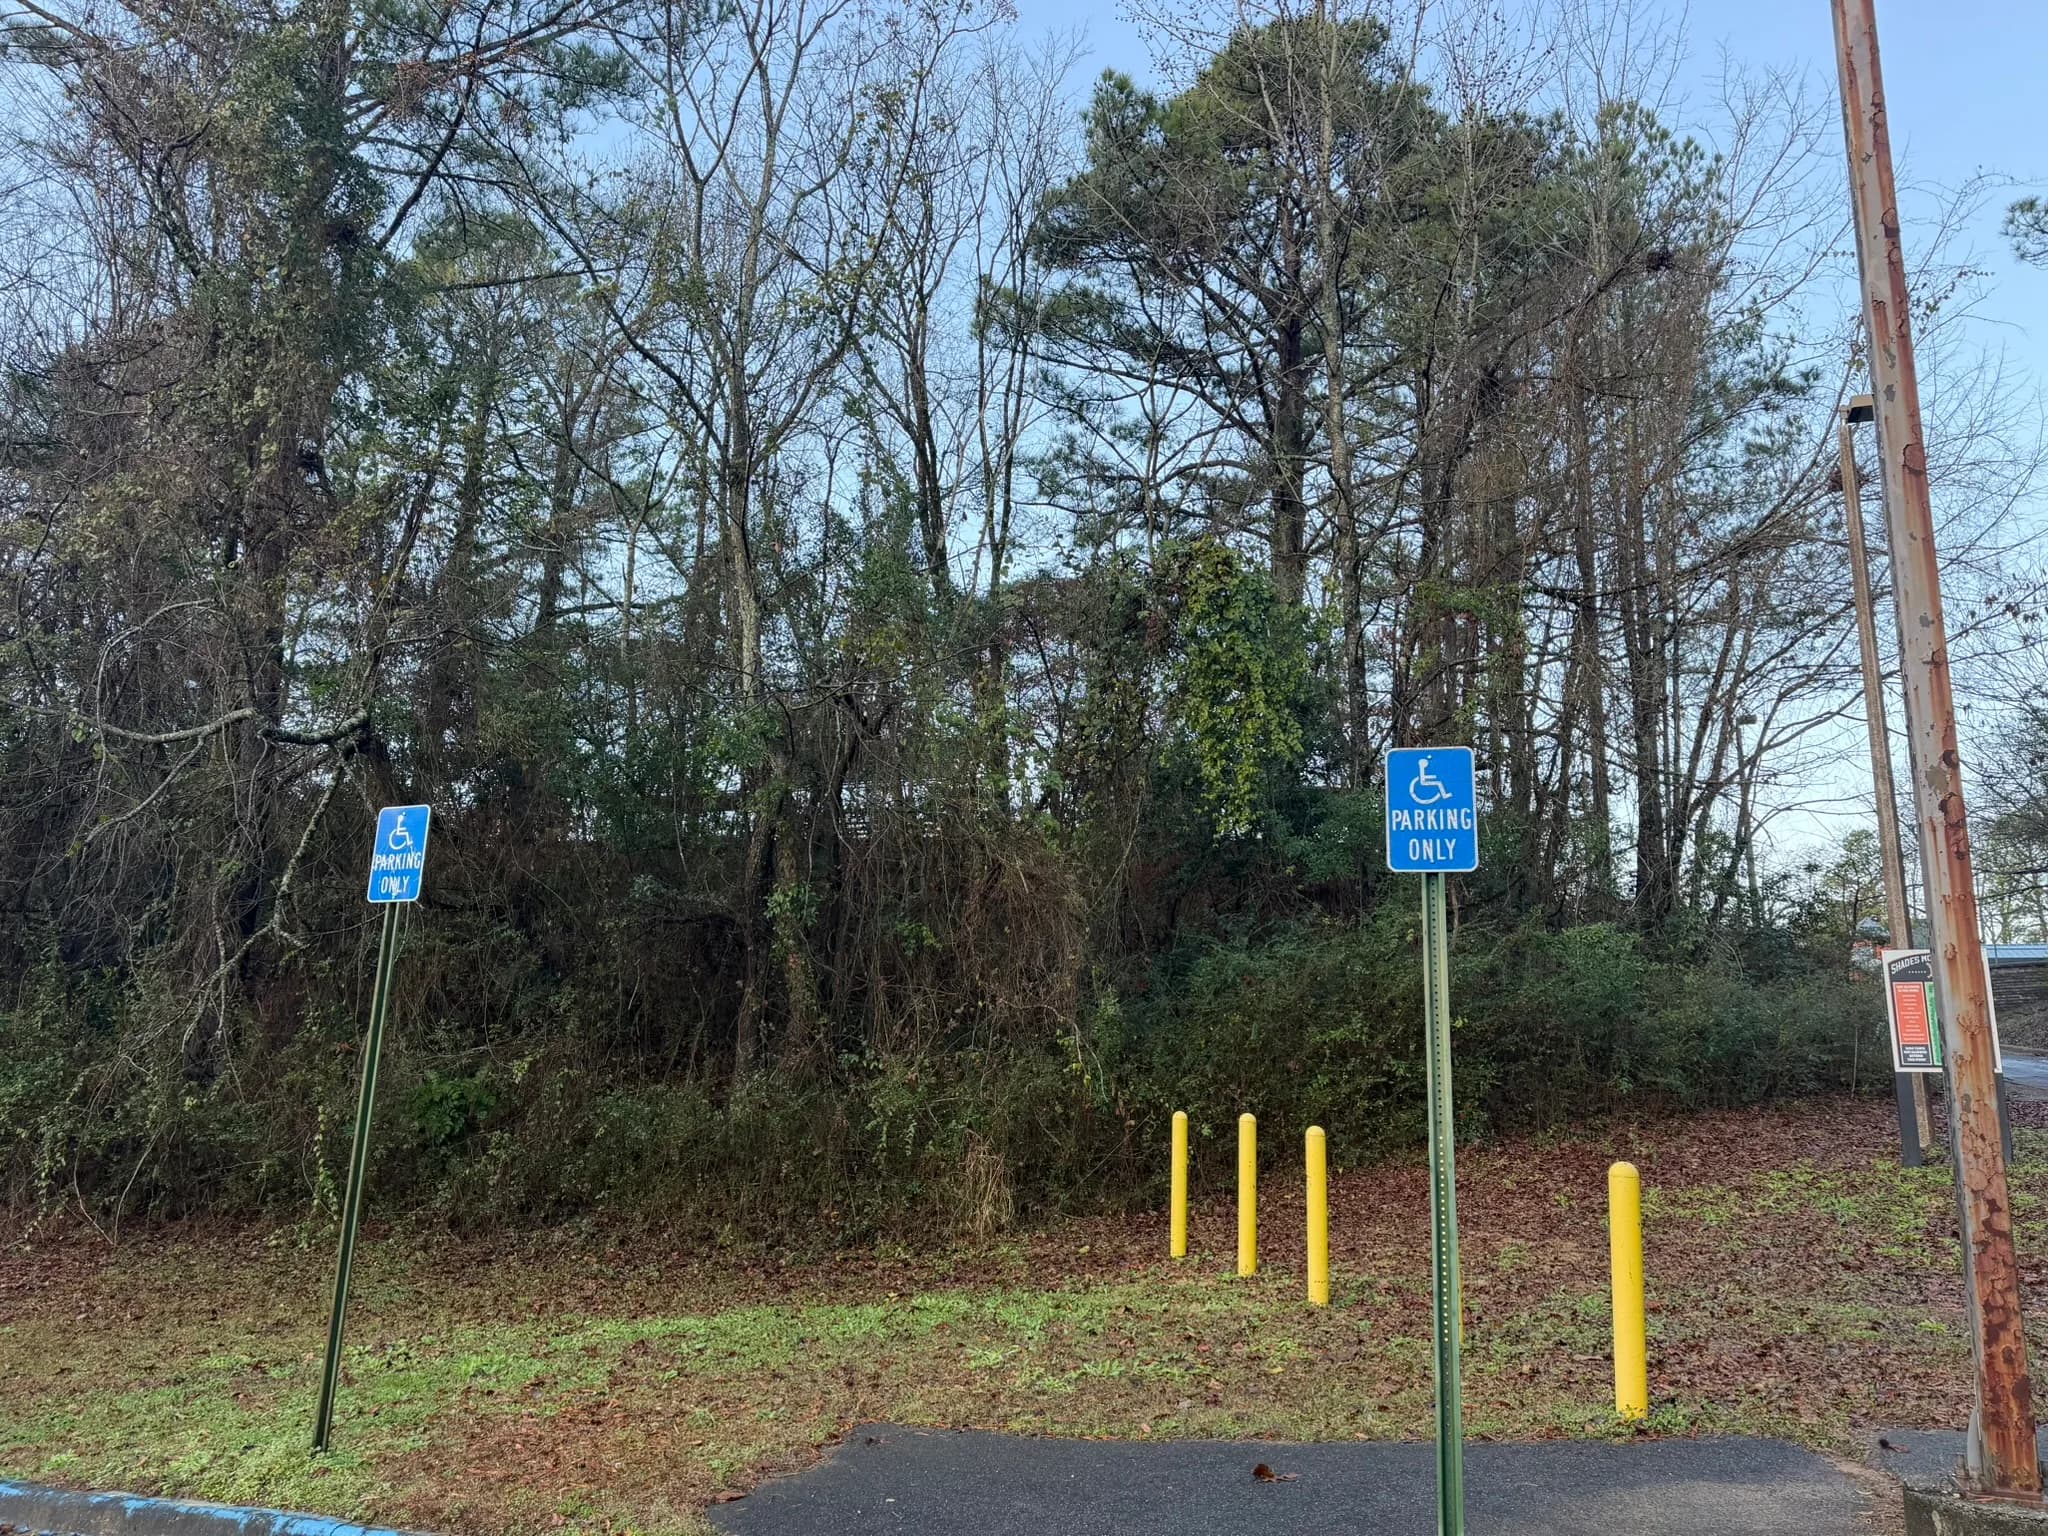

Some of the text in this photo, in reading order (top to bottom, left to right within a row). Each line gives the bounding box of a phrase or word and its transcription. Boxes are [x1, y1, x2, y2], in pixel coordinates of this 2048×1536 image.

[1391, 807, 1472, 831] PARKING
[1408, 838, 1457, 861] ONLY
[374, 852, 422, 871] PARKING
[380, 875, 410, 894] ONLY
[1891, 955, 1920, 975] SHADES
